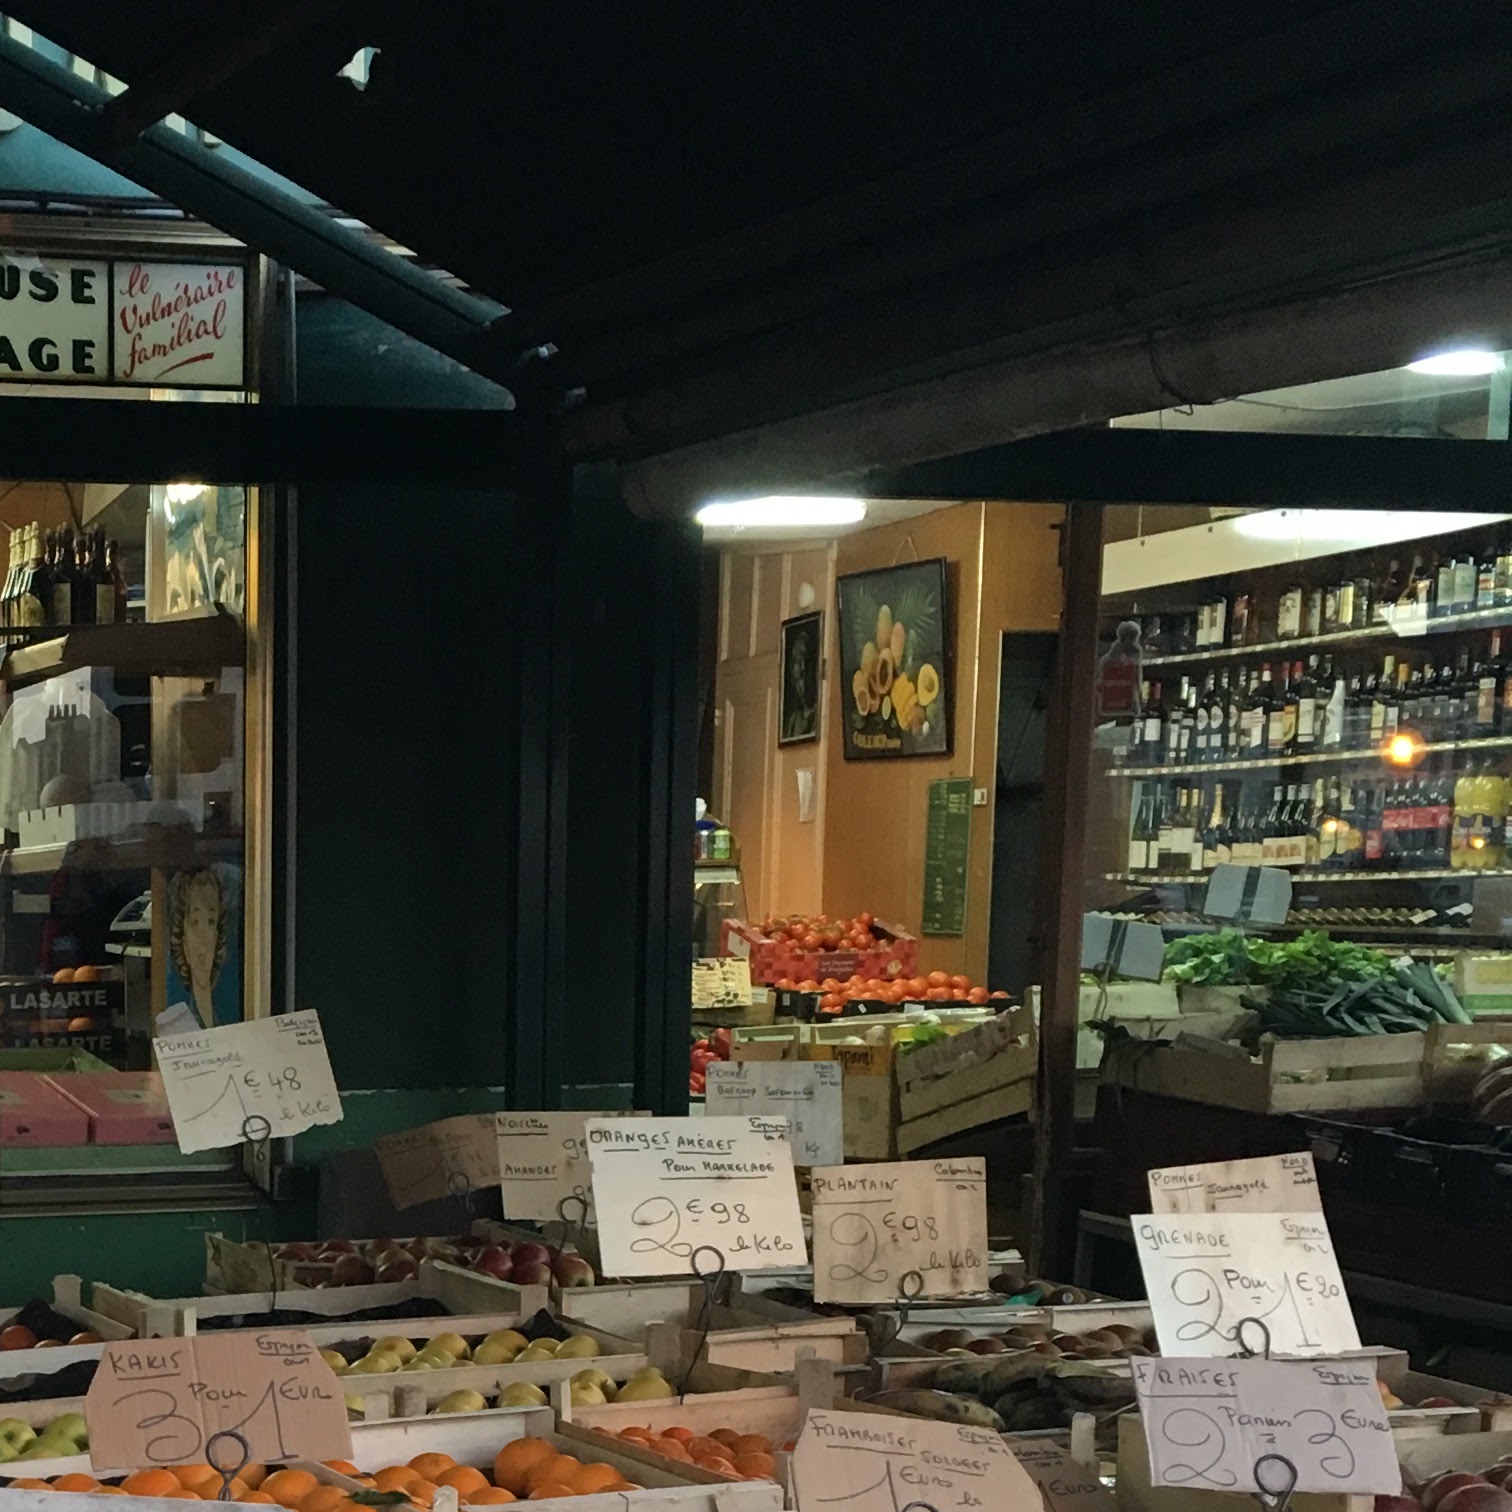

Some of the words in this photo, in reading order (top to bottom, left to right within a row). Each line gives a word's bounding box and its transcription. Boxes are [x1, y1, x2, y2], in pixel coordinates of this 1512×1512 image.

[124, 300, 228, 377] familial
[9, 988, 108, 1010] LASARTE
[14, 1034, 113, 1054] LASARTE
[589, 1130, 671, 1150] ORANGES
[815, 1177, 899, 1193] PLANTAIN
[1151, 1170, 1202, 1187] POMMES
[1140, 1223, 1231, 1250] GRENADE
[108, 1350, 184, 1374] KAKIS
[1135, 1362, 1241, 1390] FRAISES
[808, 1414, 918, 1449] FRAMBOISES
